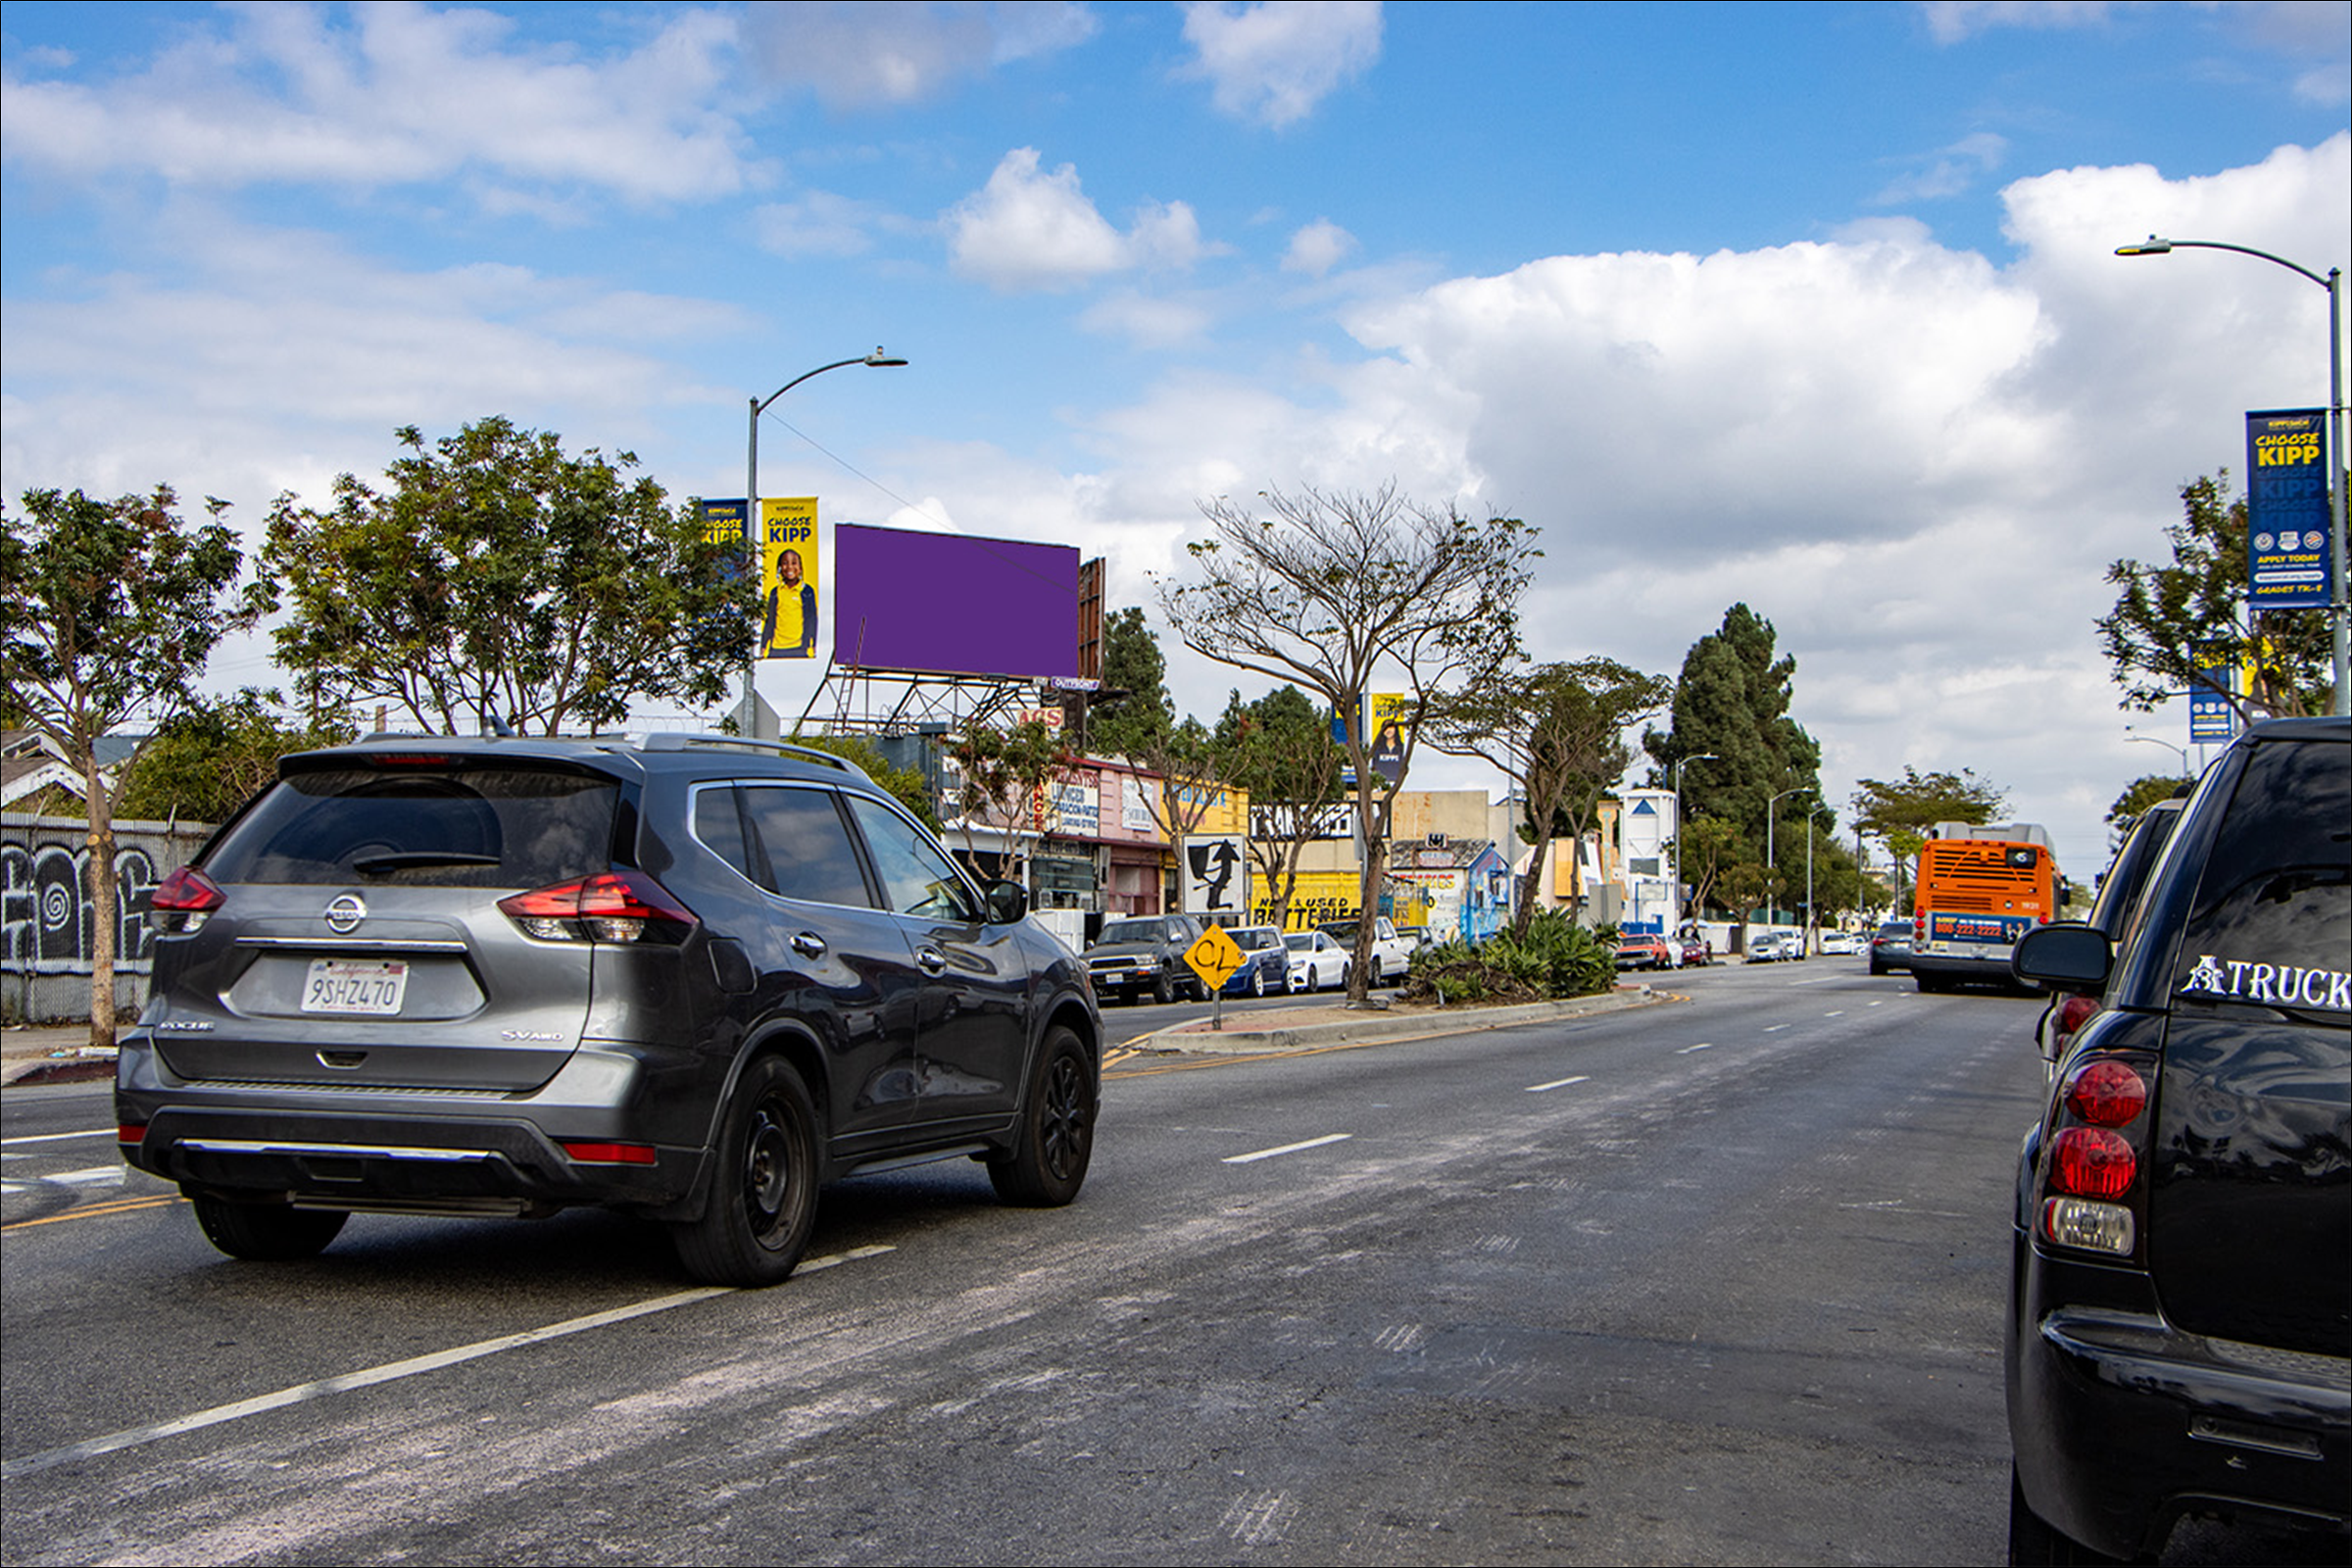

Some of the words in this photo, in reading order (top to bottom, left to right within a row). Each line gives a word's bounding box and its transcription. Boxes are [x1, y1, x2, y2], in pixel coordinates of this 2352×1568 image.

[2255, 432, 2320, 446] CHOOSE
[2258, 445, 2320, 466] KIPP
[768, 516, 811, 526] CHOOSE
[769, 527, 811, 543] KIPP
[2257, 555, 2286, 564] APPLY
[2288, 554, 2321, 563] TODAY
[2256, 585, 2295, 594] GRADES
[1306, 898, 1348, 907] USED
[1936, 923, 2002, 936] 800-222-2222
[329, 961, 384, 977] California
[310, 978, 397, 1006] 9SHZ470
